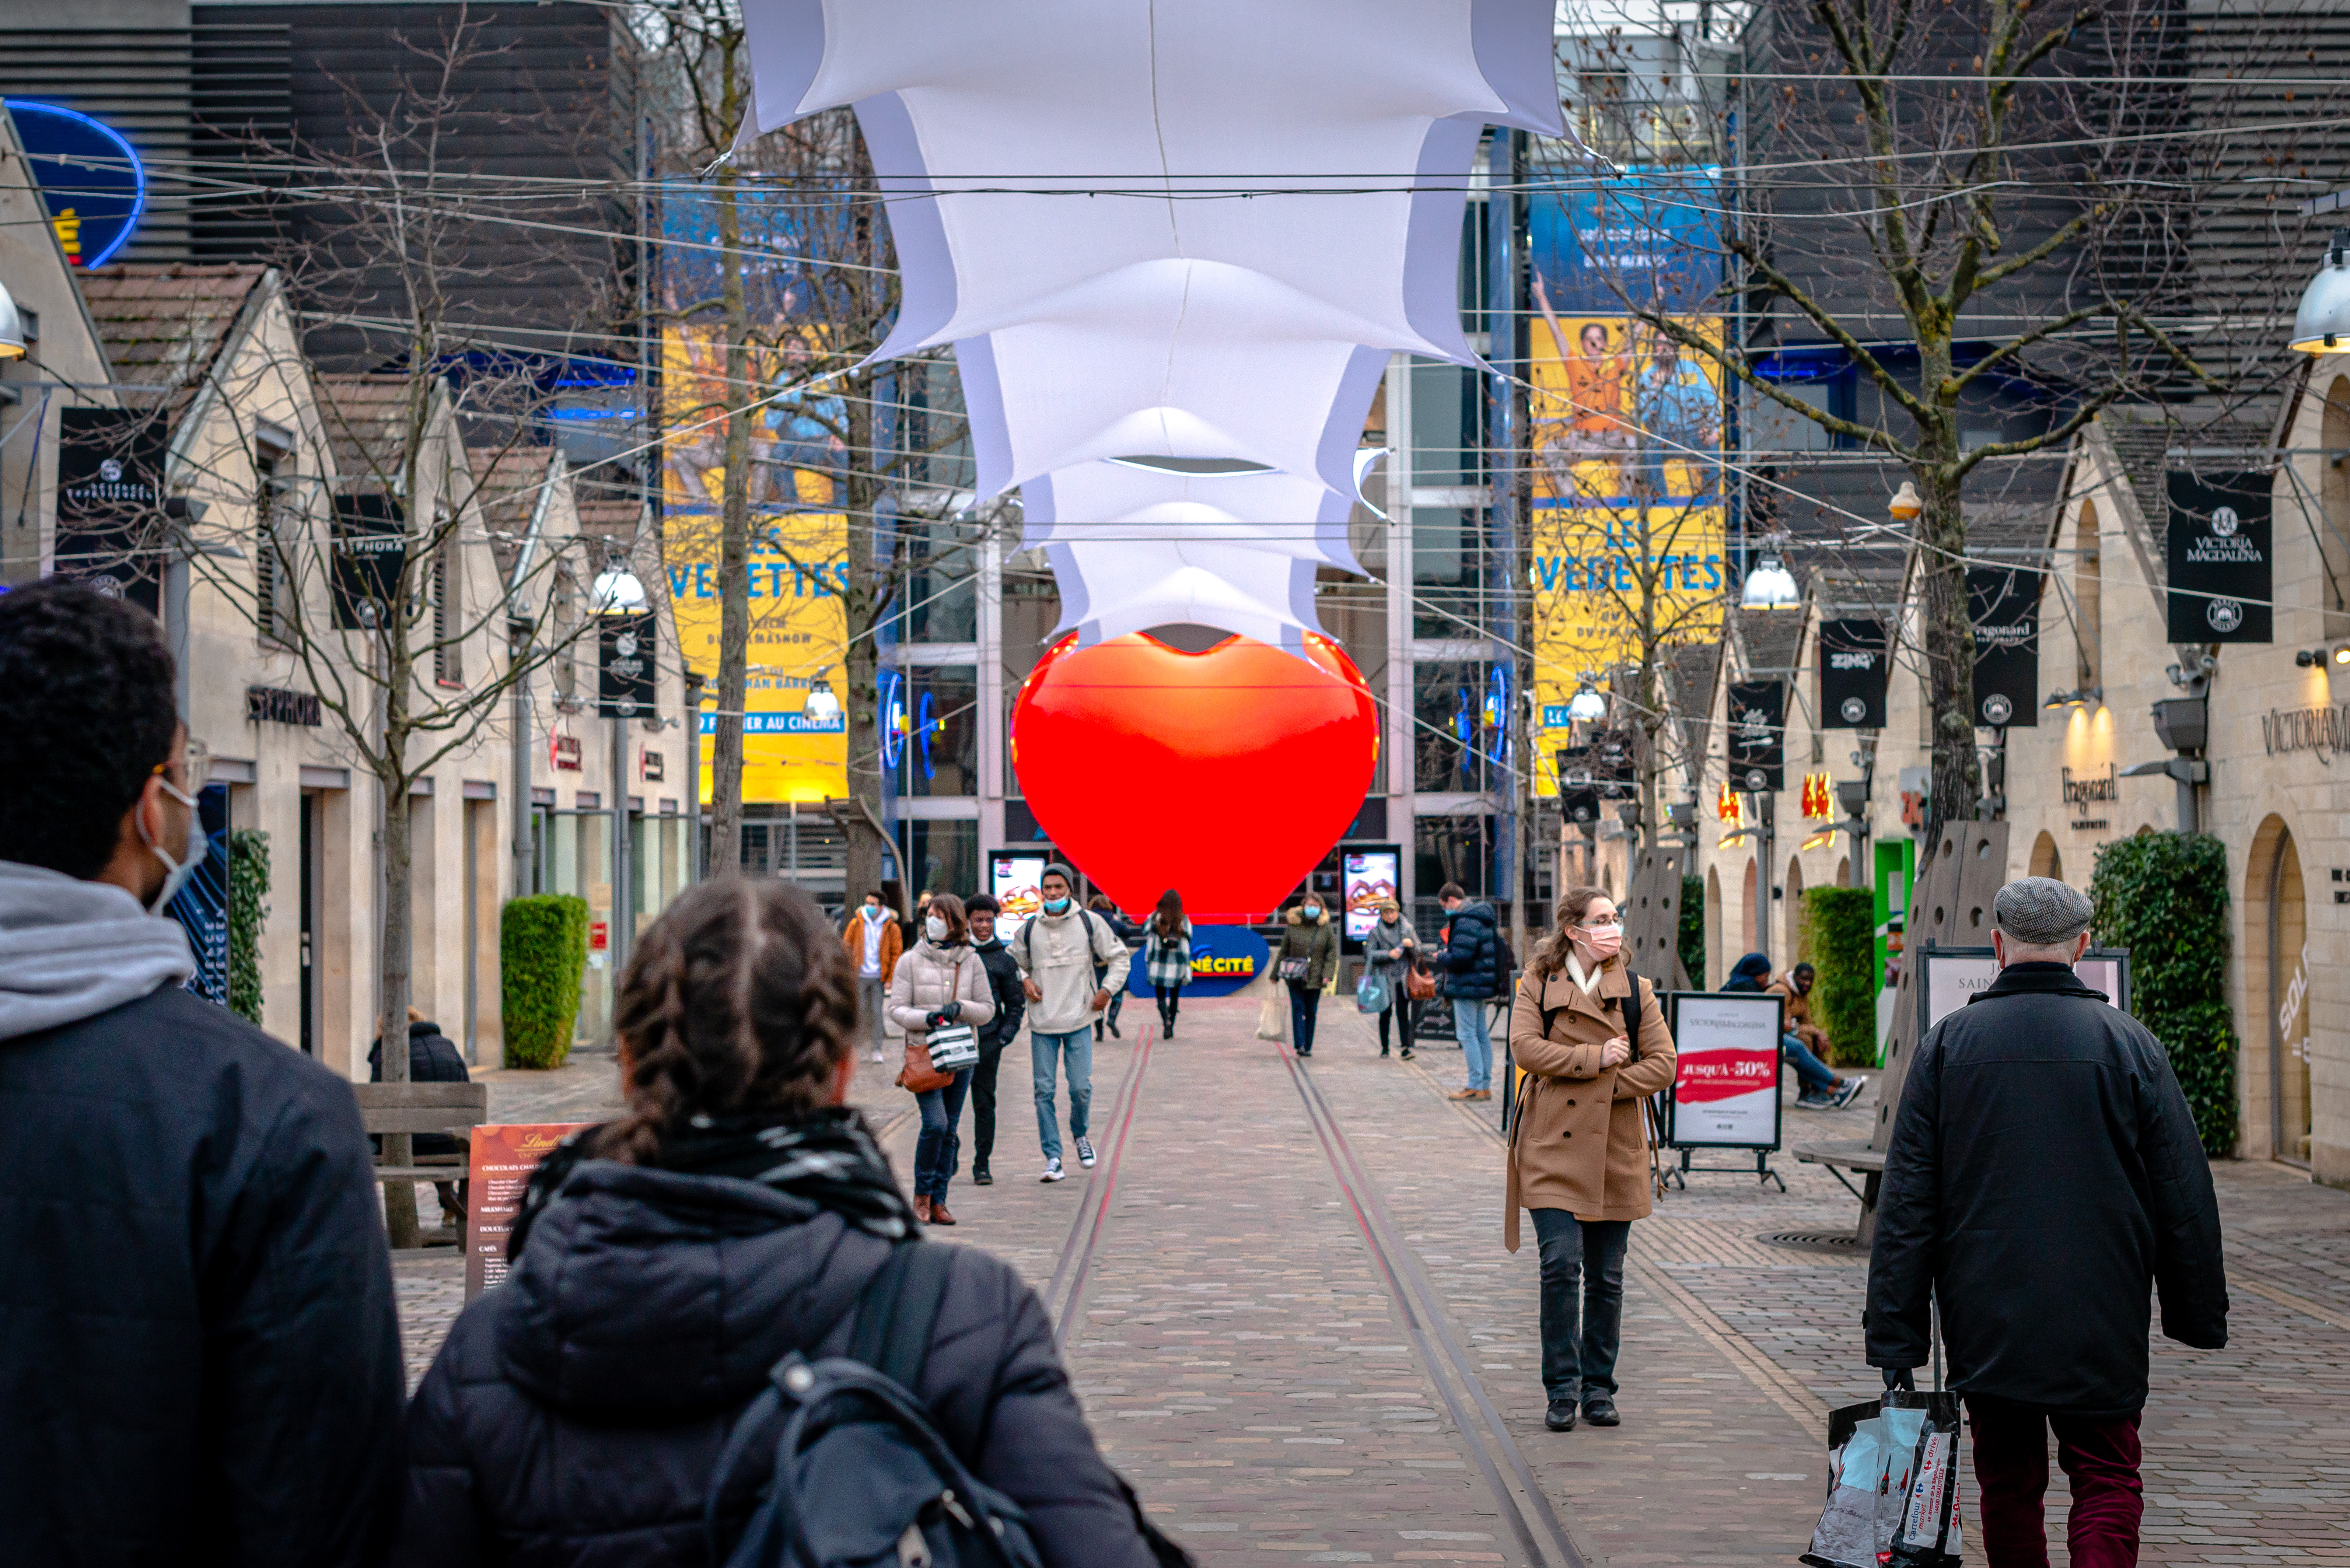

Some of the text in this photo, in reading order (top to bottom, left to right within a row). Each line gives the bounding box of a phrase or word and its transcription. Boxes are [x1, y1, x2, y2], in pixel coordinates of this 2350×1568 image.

[2195, 536, 2253, 550] VICTORIA
[2187, 548, 2262, 562] MAGDALENA
[667, 561, 849, 599] VEETTES
[1975, 622, 2030, 637] ragonard
[775, 677, 812, 689] BARR
[710, 717, 762, 730] FIER
[766, 716, 784, 730] AU
[1958, 978, 1993, 988] SAIN
[1928, 1436, 1938, 1457] drive
[1936, 1468, 1945, 1498] DEAUVILLE
[1909, 1501, 1920, 1540] Carrefour
